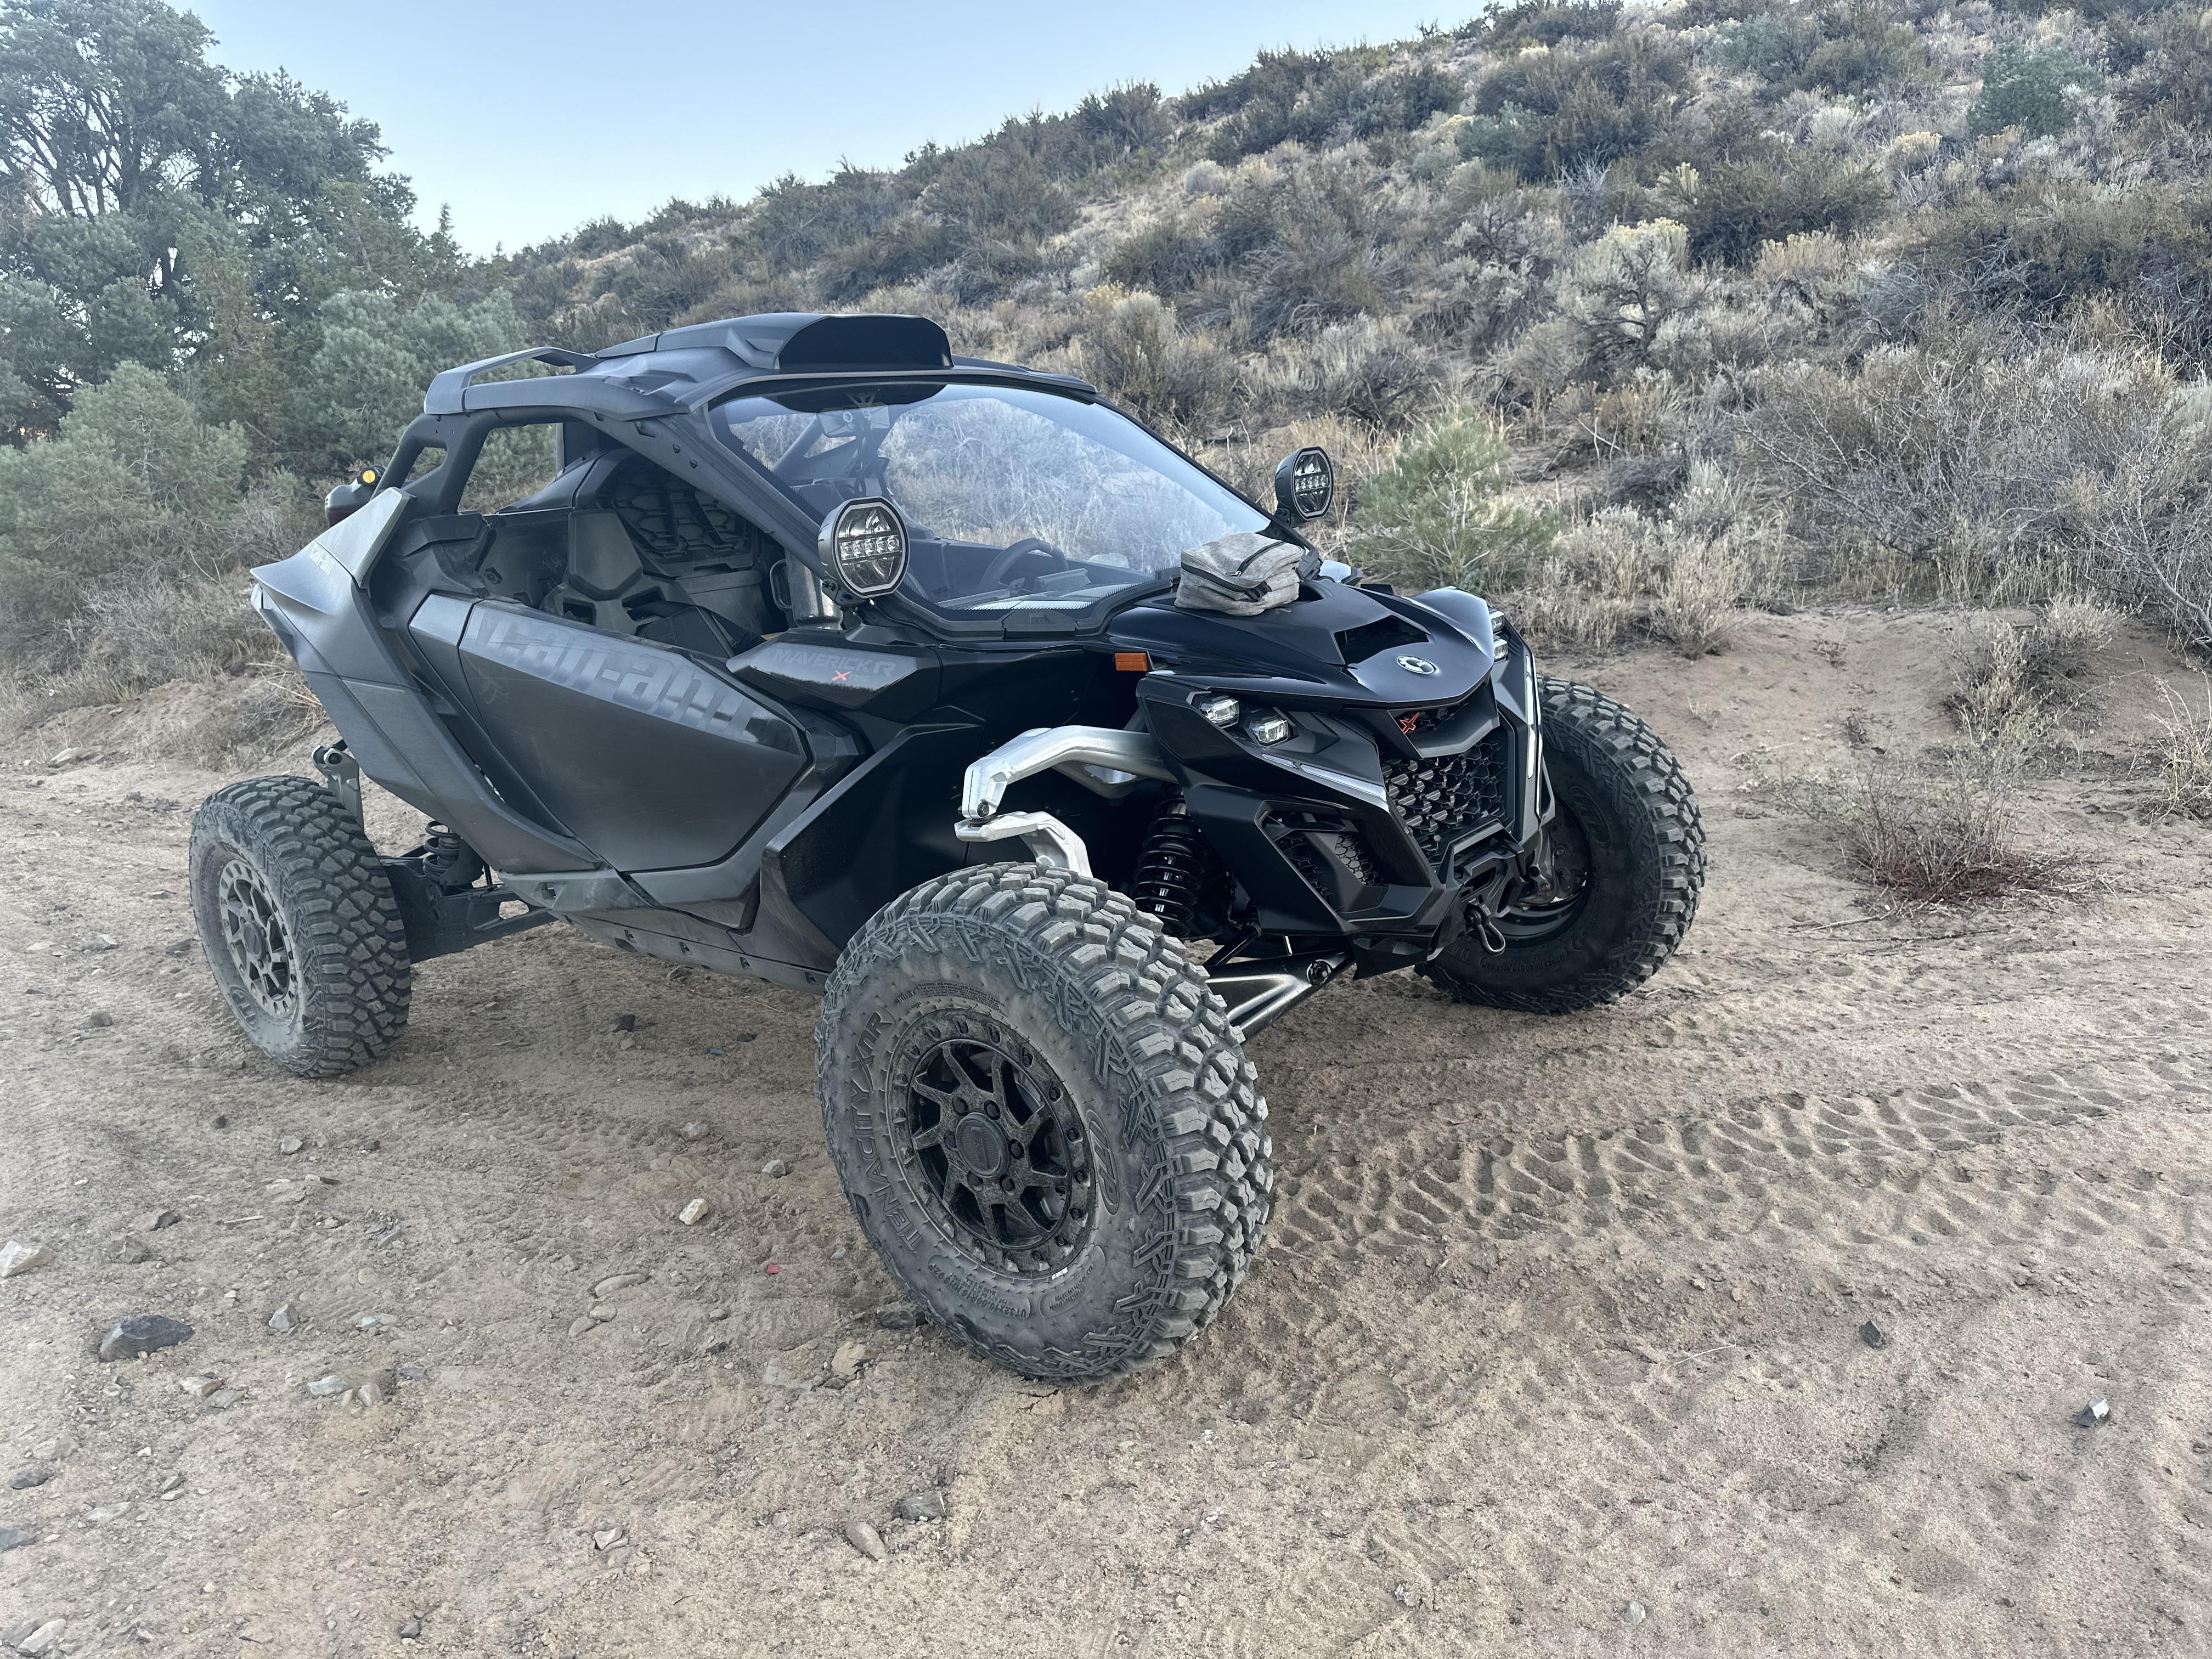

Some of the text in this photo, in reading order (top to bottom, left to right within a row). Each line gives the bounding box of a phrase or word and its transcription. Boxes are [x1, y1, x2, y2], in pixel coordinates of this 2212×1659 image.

[774, 648, 896, 678] MAVERICK R
[850, 1012, 922, 1254] TENACITY XNR
[1088, 1120, 1118, 1205] ITP
